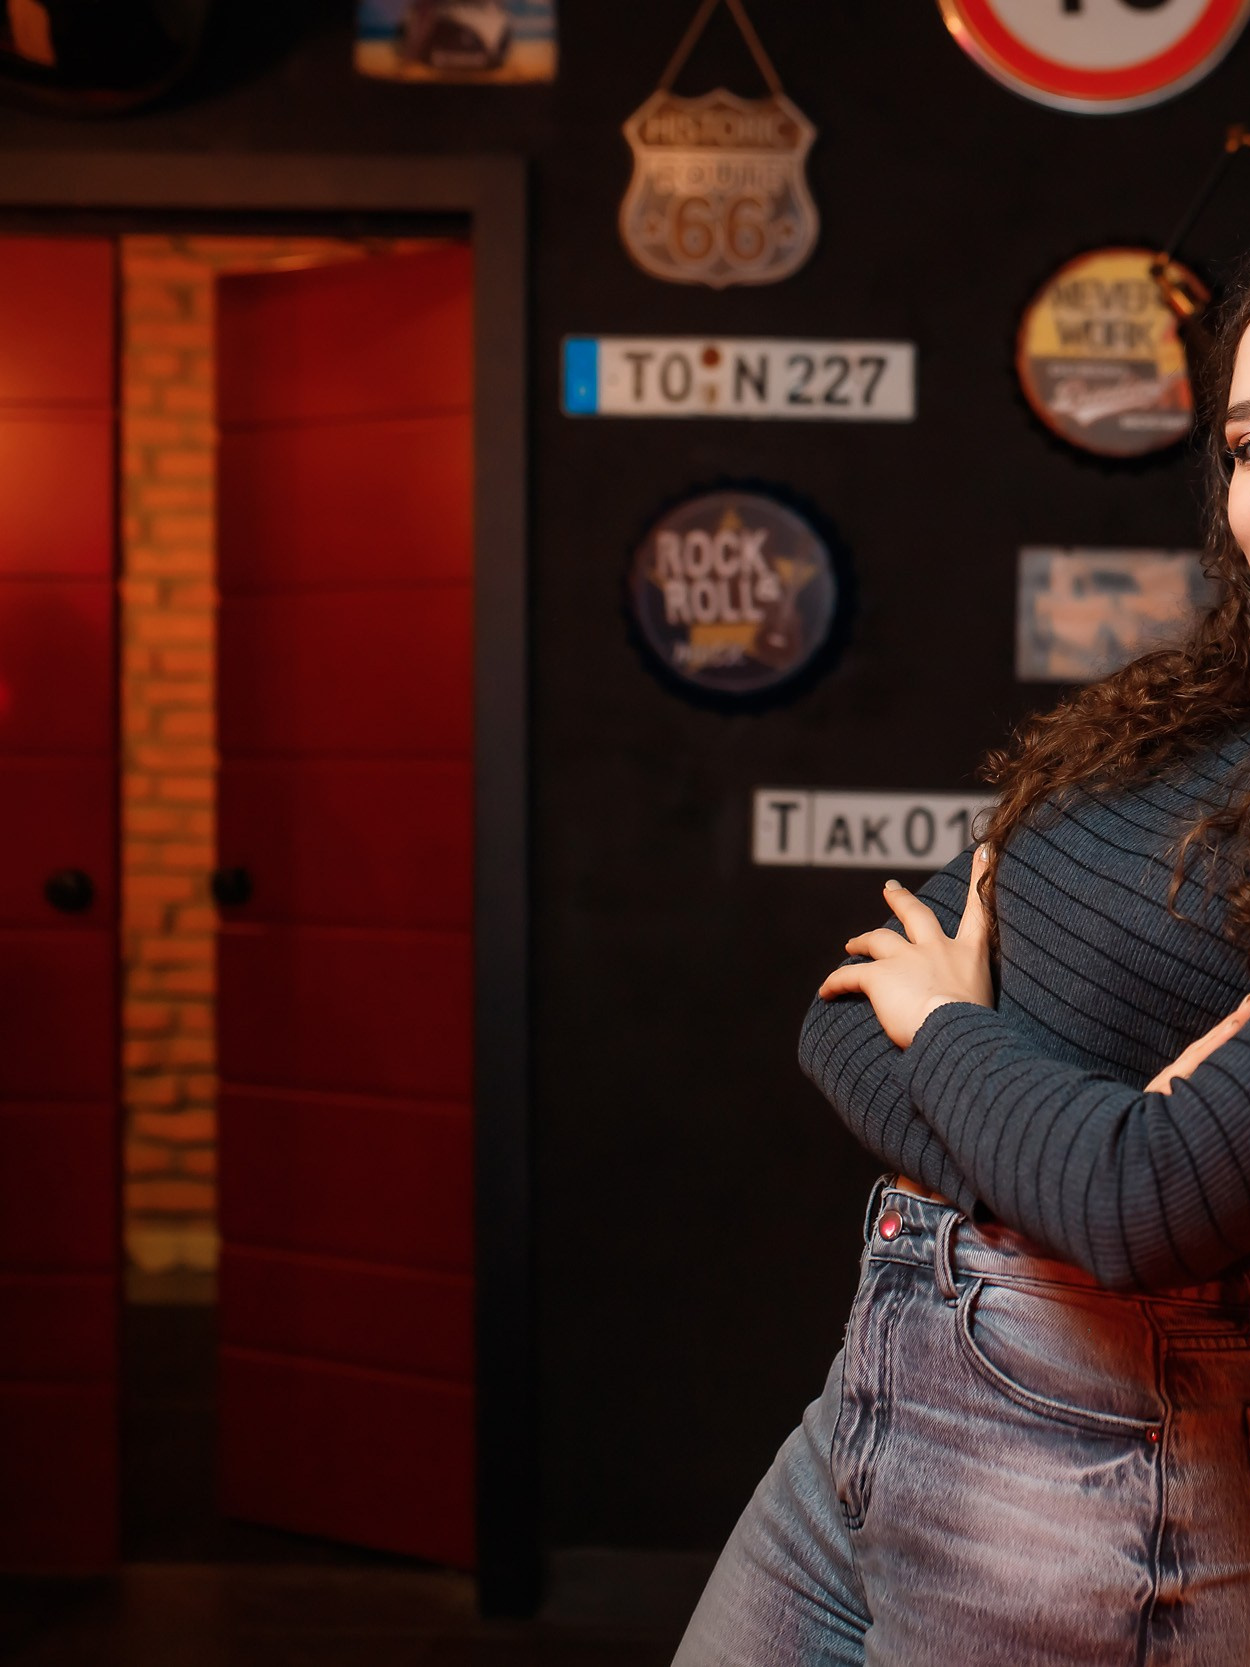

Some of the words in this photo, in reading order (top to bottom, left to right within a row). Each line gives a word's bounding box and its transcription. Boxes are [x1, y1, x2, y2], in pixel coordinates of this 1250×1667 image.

[673, 194, 769, 264] 66
[1056, 317, 1158, 352] WORK
[622, 351, 693, 403] TO
[733, 354, 770, 405] N
[786, 353, 889, 406] 227
[656, 530, 768, 578] ROCK
[664, 577, 765, 624] ROLL
[767, 801, 800, 854] T
